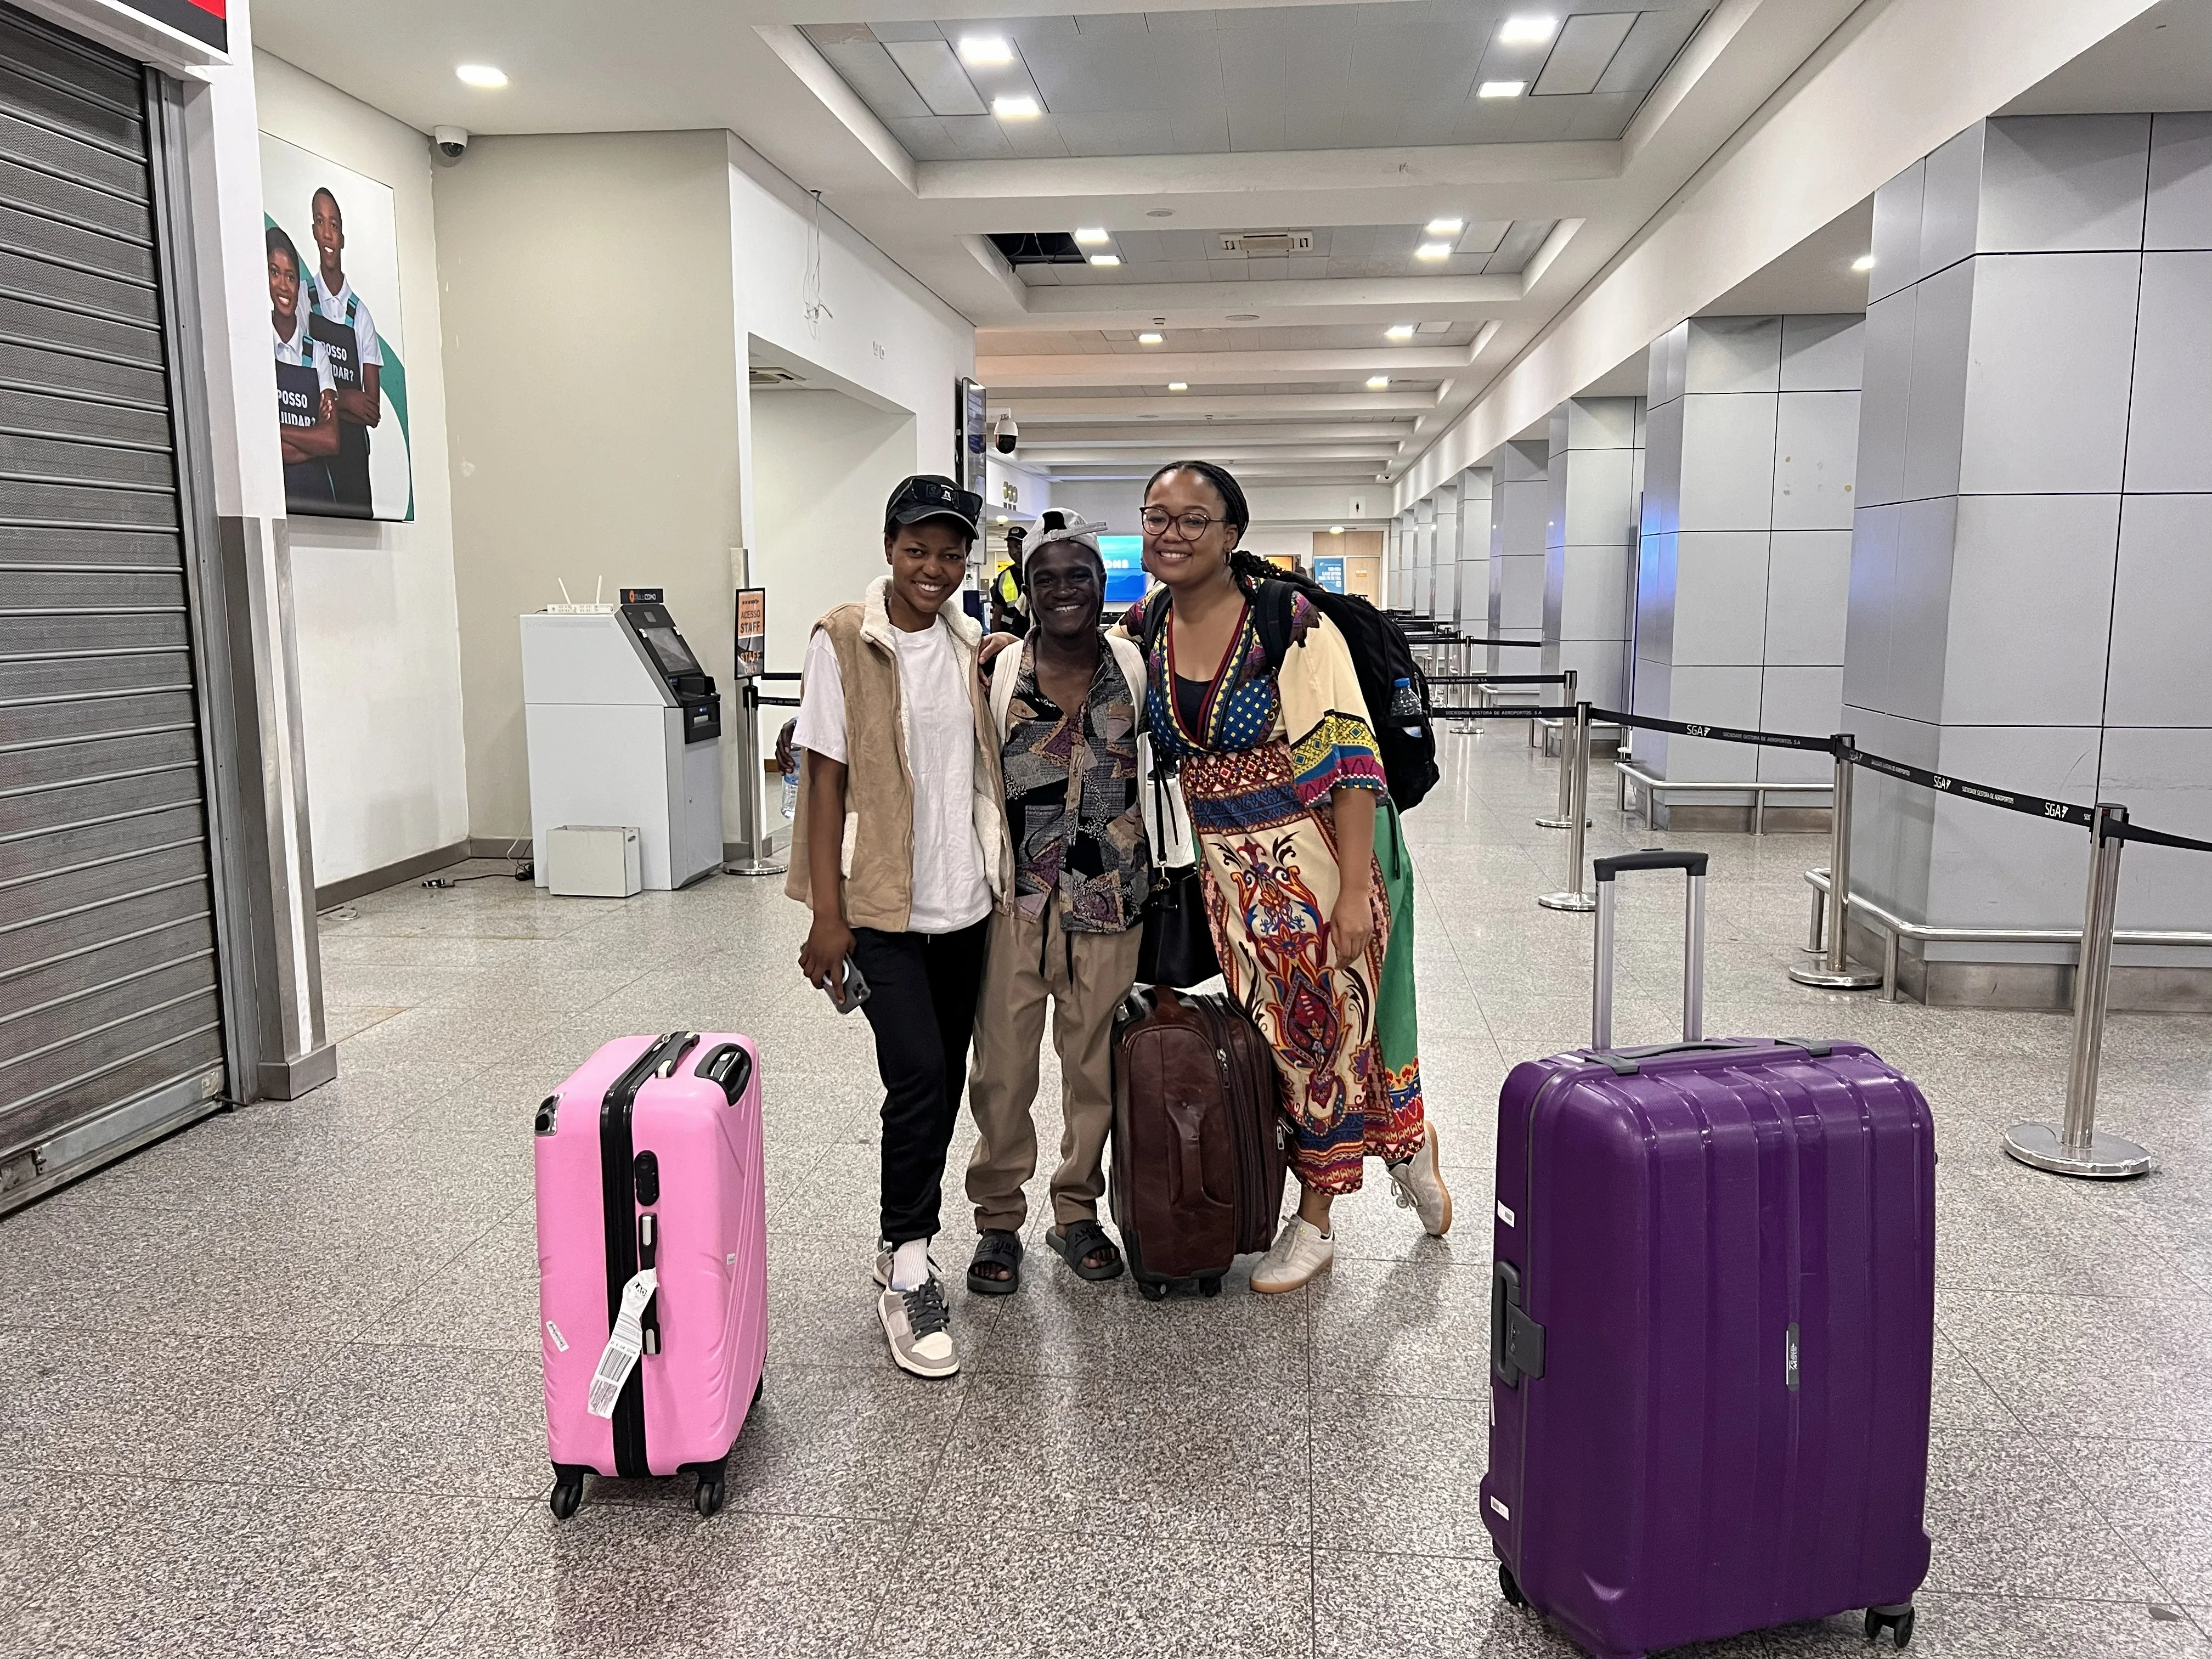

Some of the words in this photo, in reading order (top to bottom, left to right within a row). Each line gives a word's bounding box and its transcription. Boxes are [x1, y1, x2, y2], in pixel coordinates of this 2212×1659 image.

[333, 364, 354, 382] DAR?
[280, 411, 316, 427] JUDAR?
[741, 610, 761, 619] ACESSO
[741, 621, 760, 634] STAFF
[741, 650, 760, 663] STAFF
[744, 664, 758, 674] ONLY
